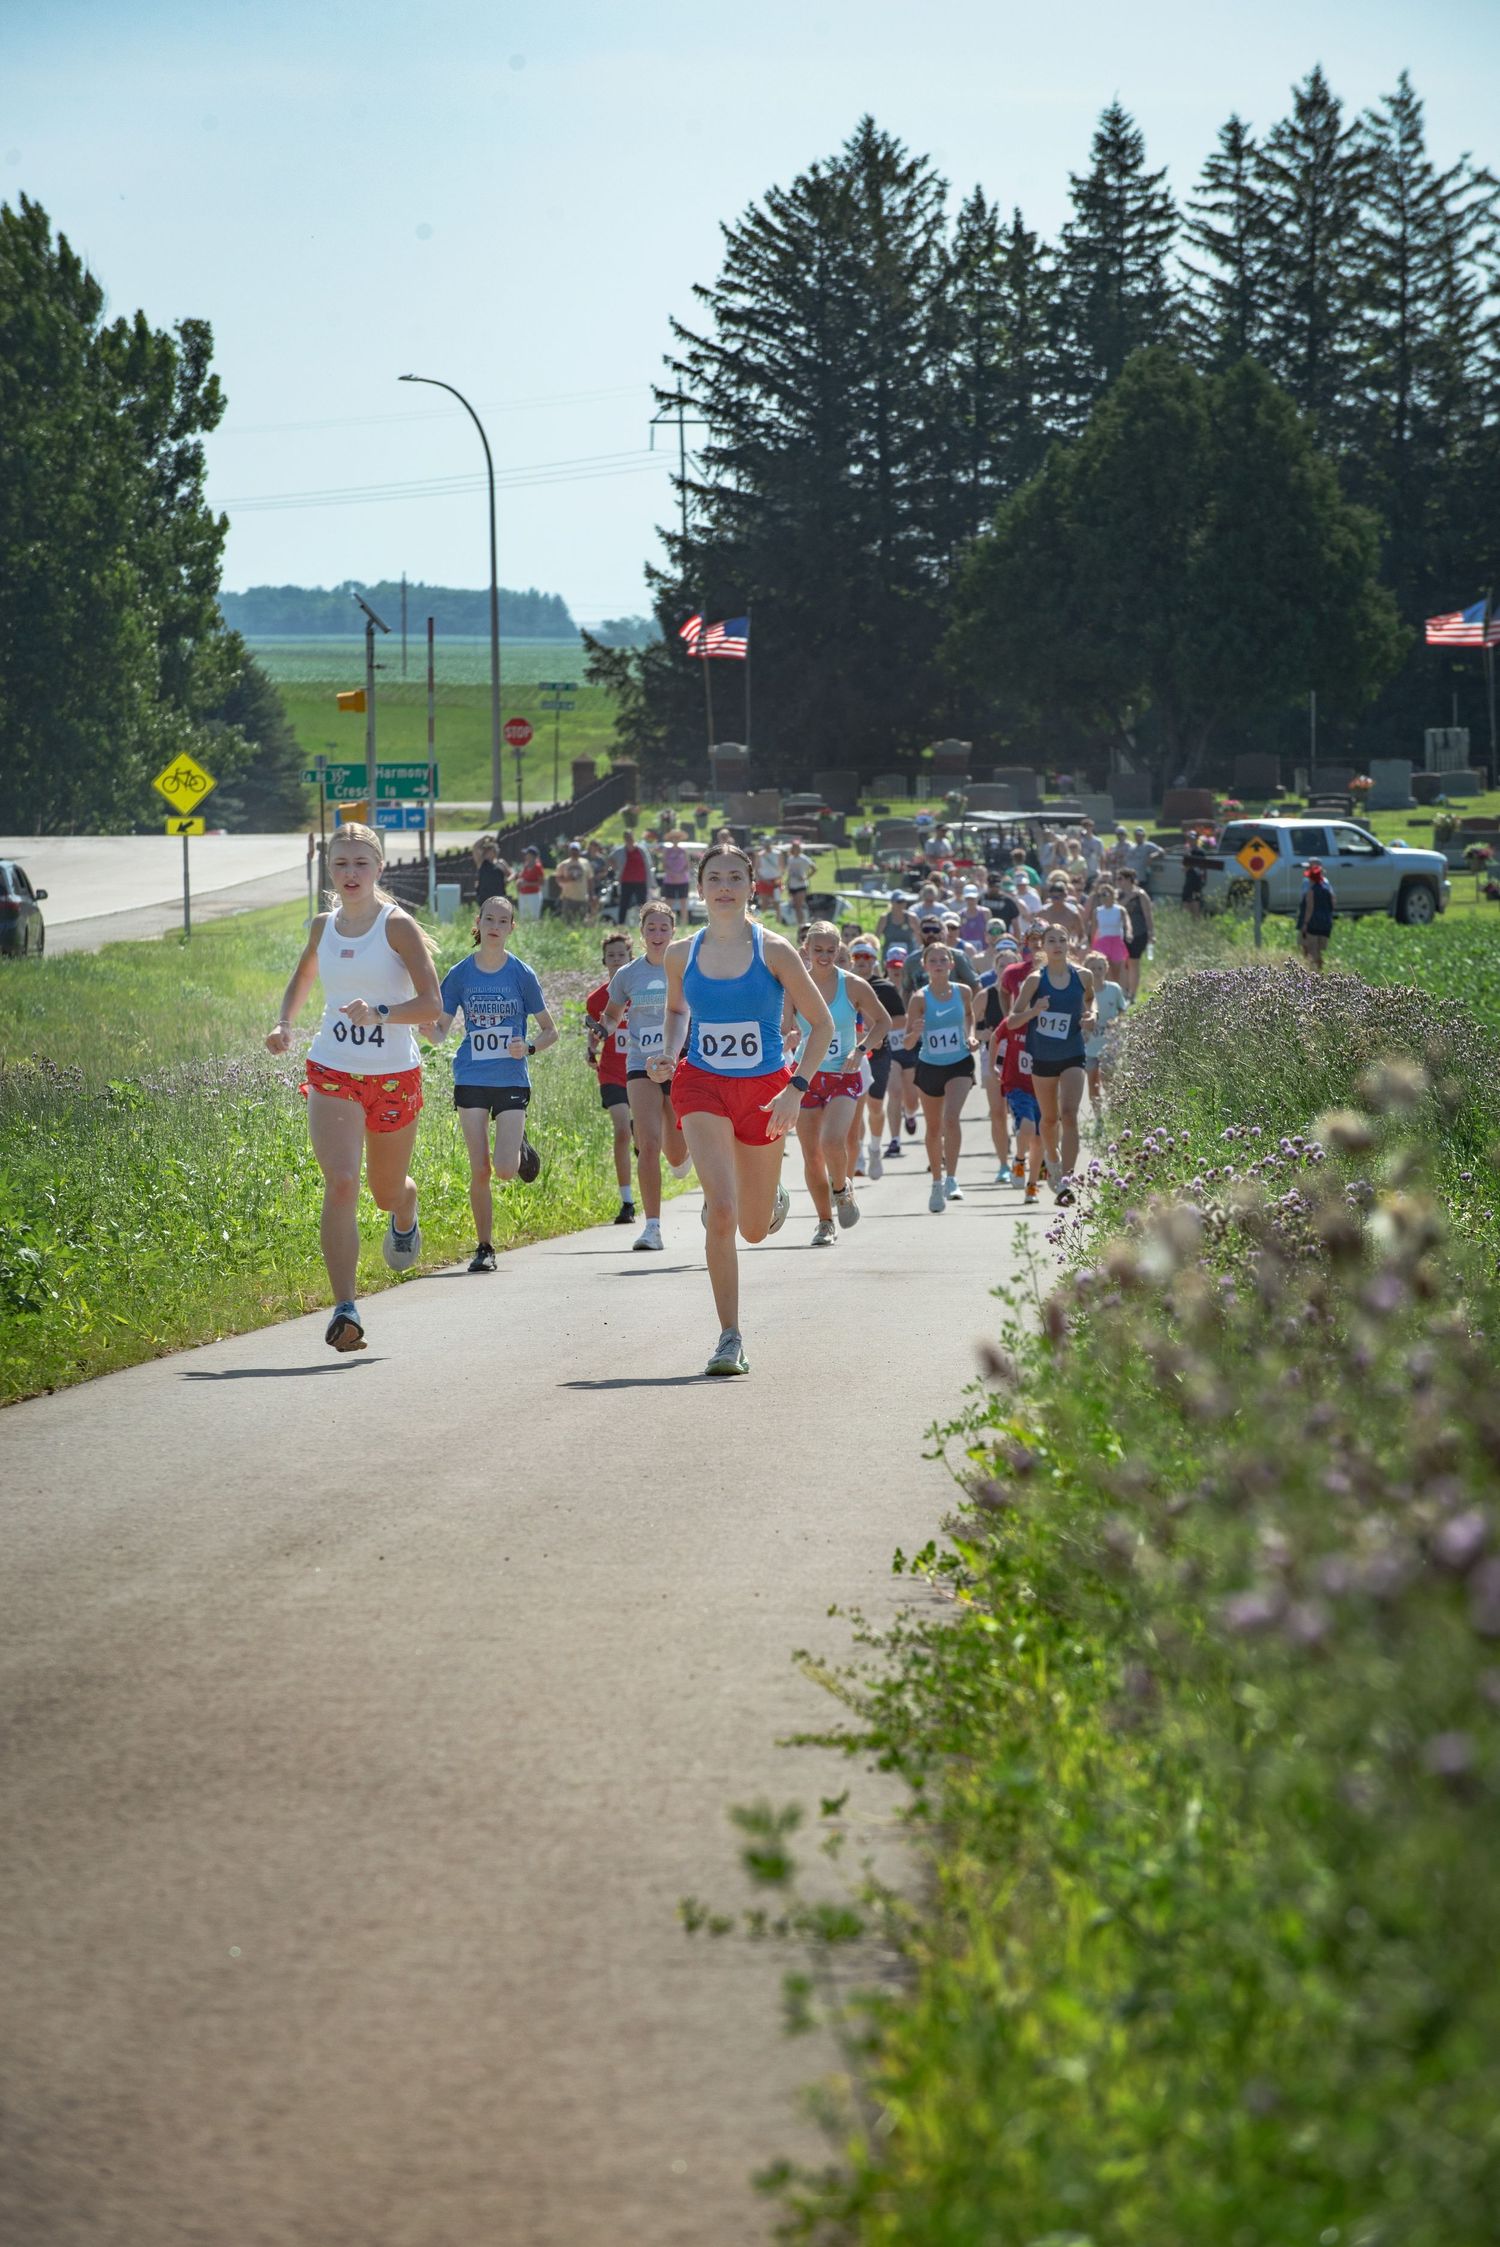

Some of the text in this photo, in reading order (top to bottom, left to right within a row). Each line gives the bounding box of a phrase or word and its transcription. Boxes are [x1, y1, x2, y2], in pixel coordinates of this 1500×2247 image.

[504, 725, 532, 739] STOP
[376, 766, 429, 780] Harmony
[334, 785, 371, 798] Cresc
[1040, 1016, 1068, 1032] 015
[333, 1021, 385, 1048] 004
[473, 1033, 509, 1051] 007
[929, 1032, 958, 1048] 014
[702, 1033, 758, 1057] 026
[828, 1039, 839, 1055] 5
